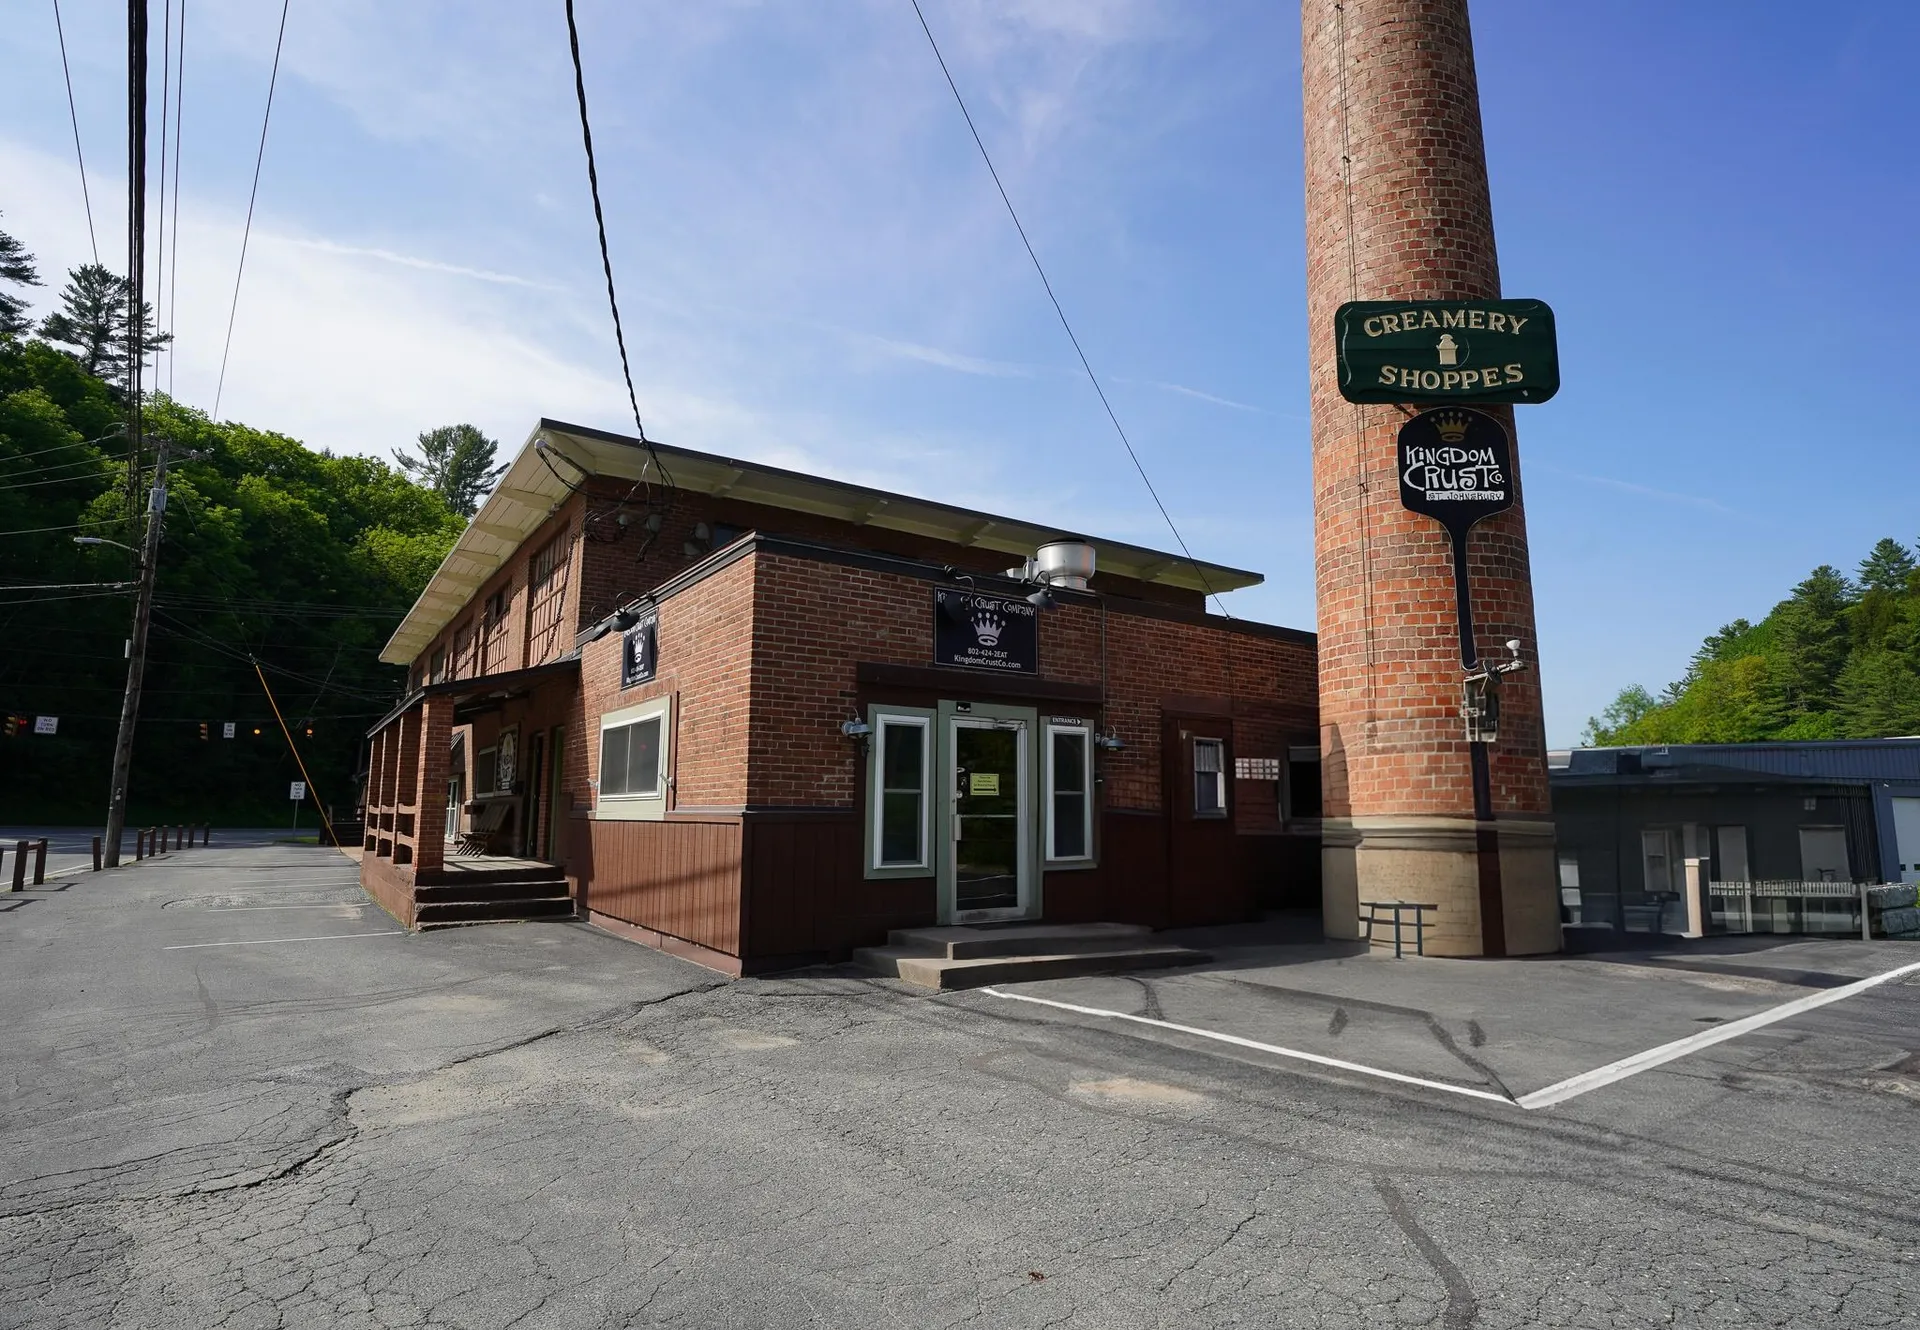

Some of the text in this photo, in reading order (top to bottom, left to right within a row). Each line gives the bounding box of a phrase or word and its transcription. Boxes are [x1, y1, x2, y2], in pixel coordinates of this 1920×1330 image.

[1363, 309, 1528, 337] CREAMERY
[1378, 363, 1524, 390] SHOPPES
[1403, 461, 1499, 491] CRUST
[975, 597, 1001, 610] CRUST
[967, 647, 1008, 658] 802-424-2EAT
[954, 654, 1021, 669] KingdomCrustCo.com
[1052, 716, 1077, 724] ENTRANCE
